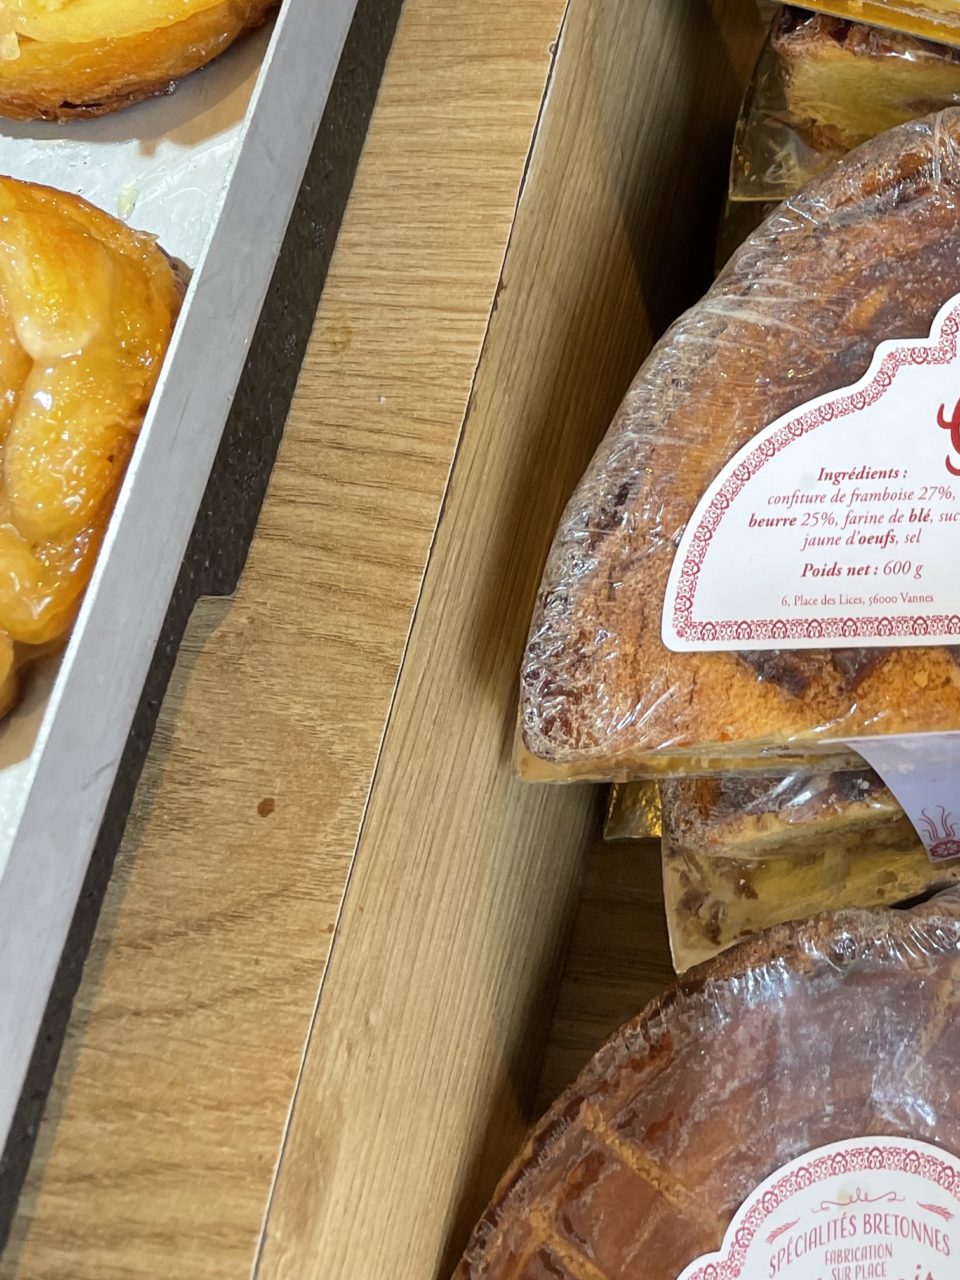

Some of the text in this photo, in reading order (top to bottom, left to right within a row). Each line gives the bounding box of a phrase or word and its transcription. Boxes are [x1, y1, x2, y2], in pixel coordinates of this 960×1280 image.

[768, 485, 956, 509] confiture de framboise 27%,
[749, 513, 797, 528] beurre
[801, 512, 838, 526] 25%,
[841, 510, 883, 529] farine
[889, 509, 903, 524] de
[908, 508, 934, 523] blé,
[800, 532, 841, 550] jaune
[904, 528, 921, 544] sel
[801, 562, 842, 577] Poids
[883, 561, 911, 574] 600
[782, 592, 934, 607] 6, Place des Lices, 56000 Vannes
[769, 1212, 950, 1278] SPÉCIALITÉS BRETONNES
[825, 1243, 893, 1265] FABRICATION
[831, 1265, 850, 1280] SUR
[855, 1262, 886, 1278] PLACE
